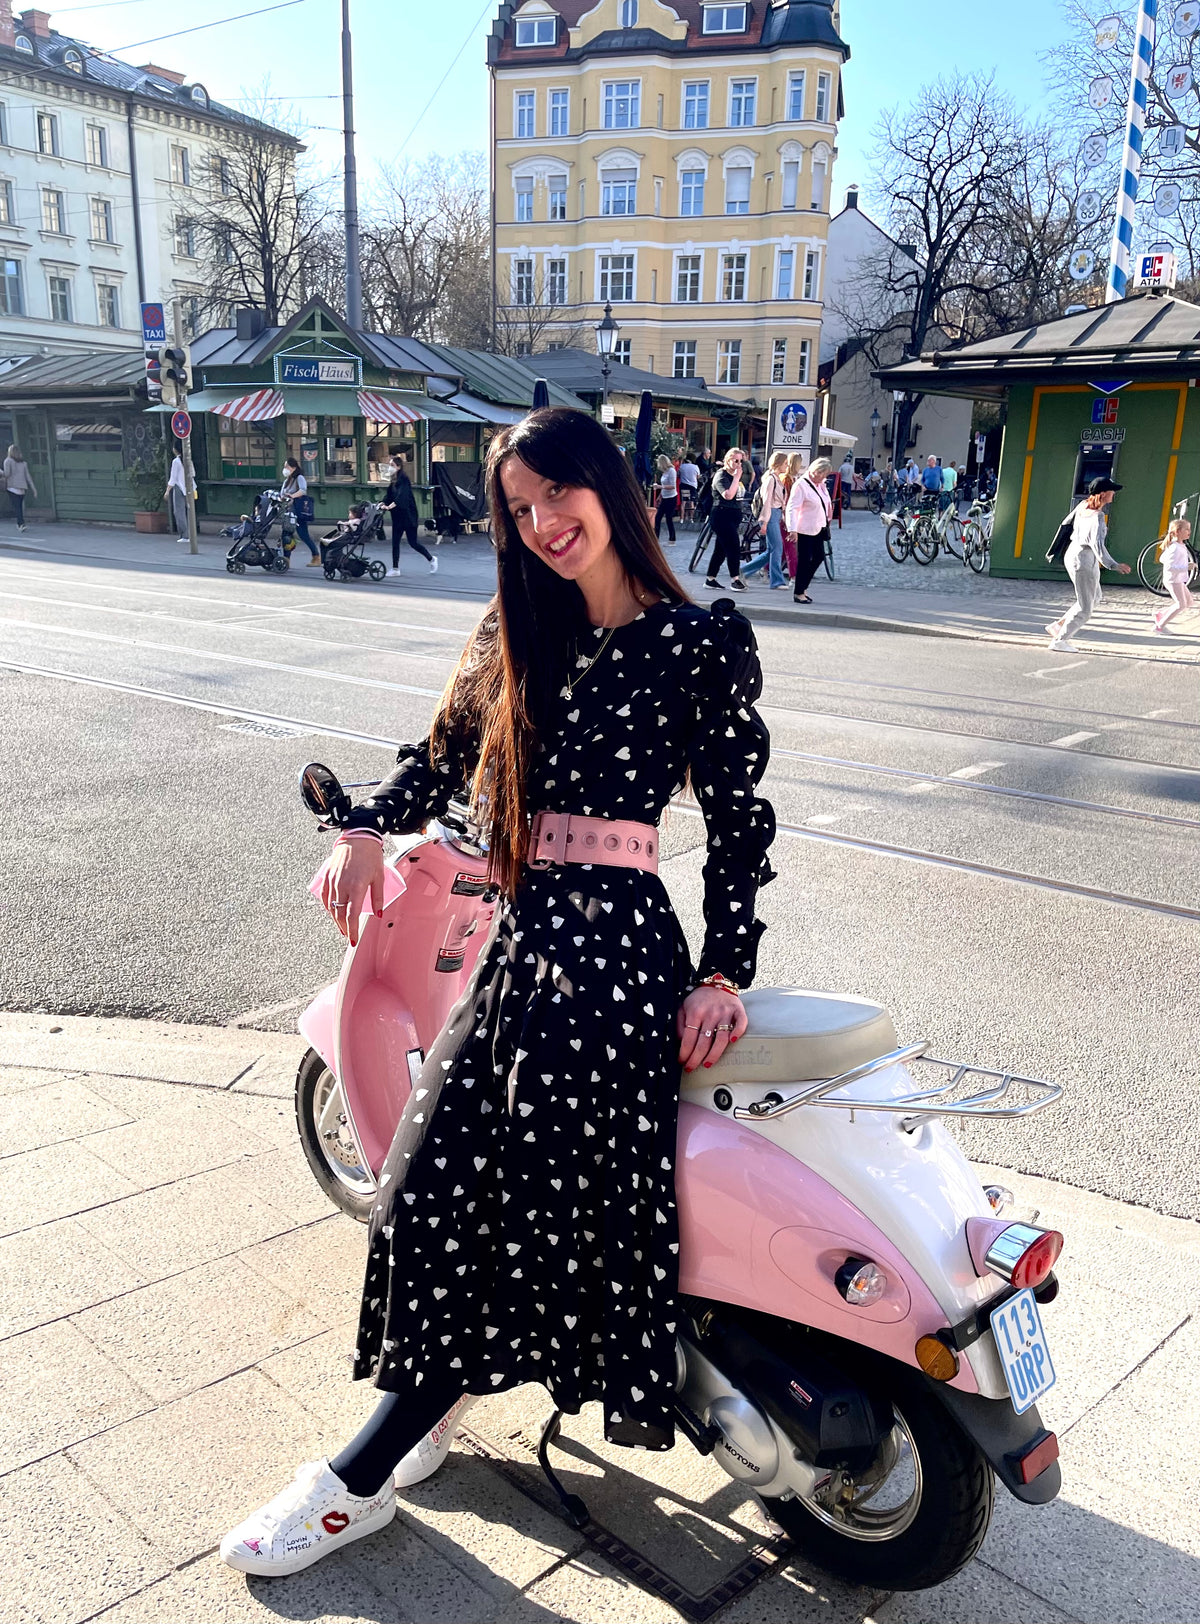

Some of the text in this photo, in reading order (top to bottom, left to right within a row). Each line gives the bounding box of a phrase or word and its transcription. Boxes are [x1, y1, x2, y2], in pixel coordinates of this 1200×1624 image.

[1140, 278, 1161, 287] ATM
[145, 329, 164, 339] TAXI
[782, 435, 803, 444] ZONE
[1081, 427, 1126, 441] CASH
[999, 1297, 1037, 1354] 113
[1010, 1343, 1045, 1401] URP
[724, 1441, 761, 1473] MOTORS
[286, 1535, 308, 1546] LOVIN
[287, 1541, 312, 1554] MYSELF
